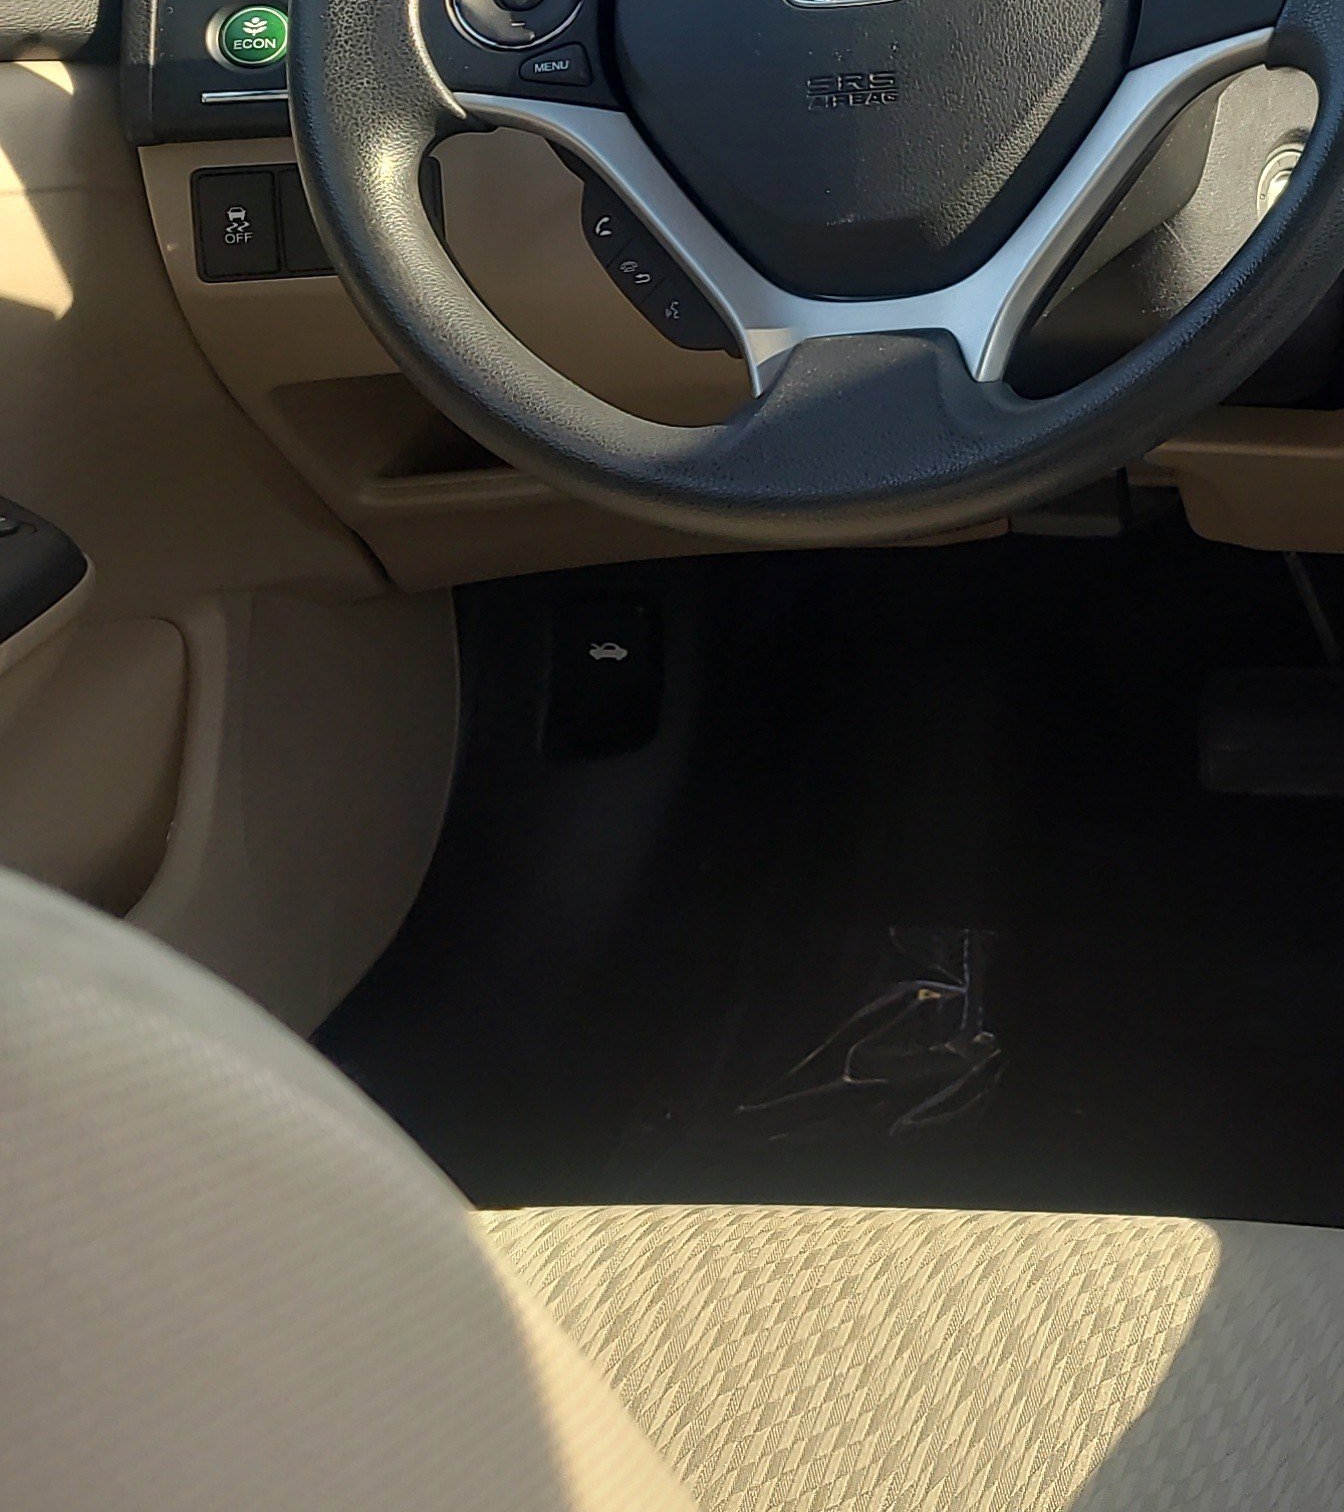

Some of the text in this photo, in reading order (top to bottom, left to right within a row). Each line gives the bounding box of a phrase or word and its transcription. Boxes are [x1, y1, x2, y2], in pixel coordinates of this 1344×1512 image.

[233, 38, 277, 50] ECON
[534, 60, 570, 73] MENU
[806, 71, 897, 94] SRS
[224, 232, 253, 244] OFF
